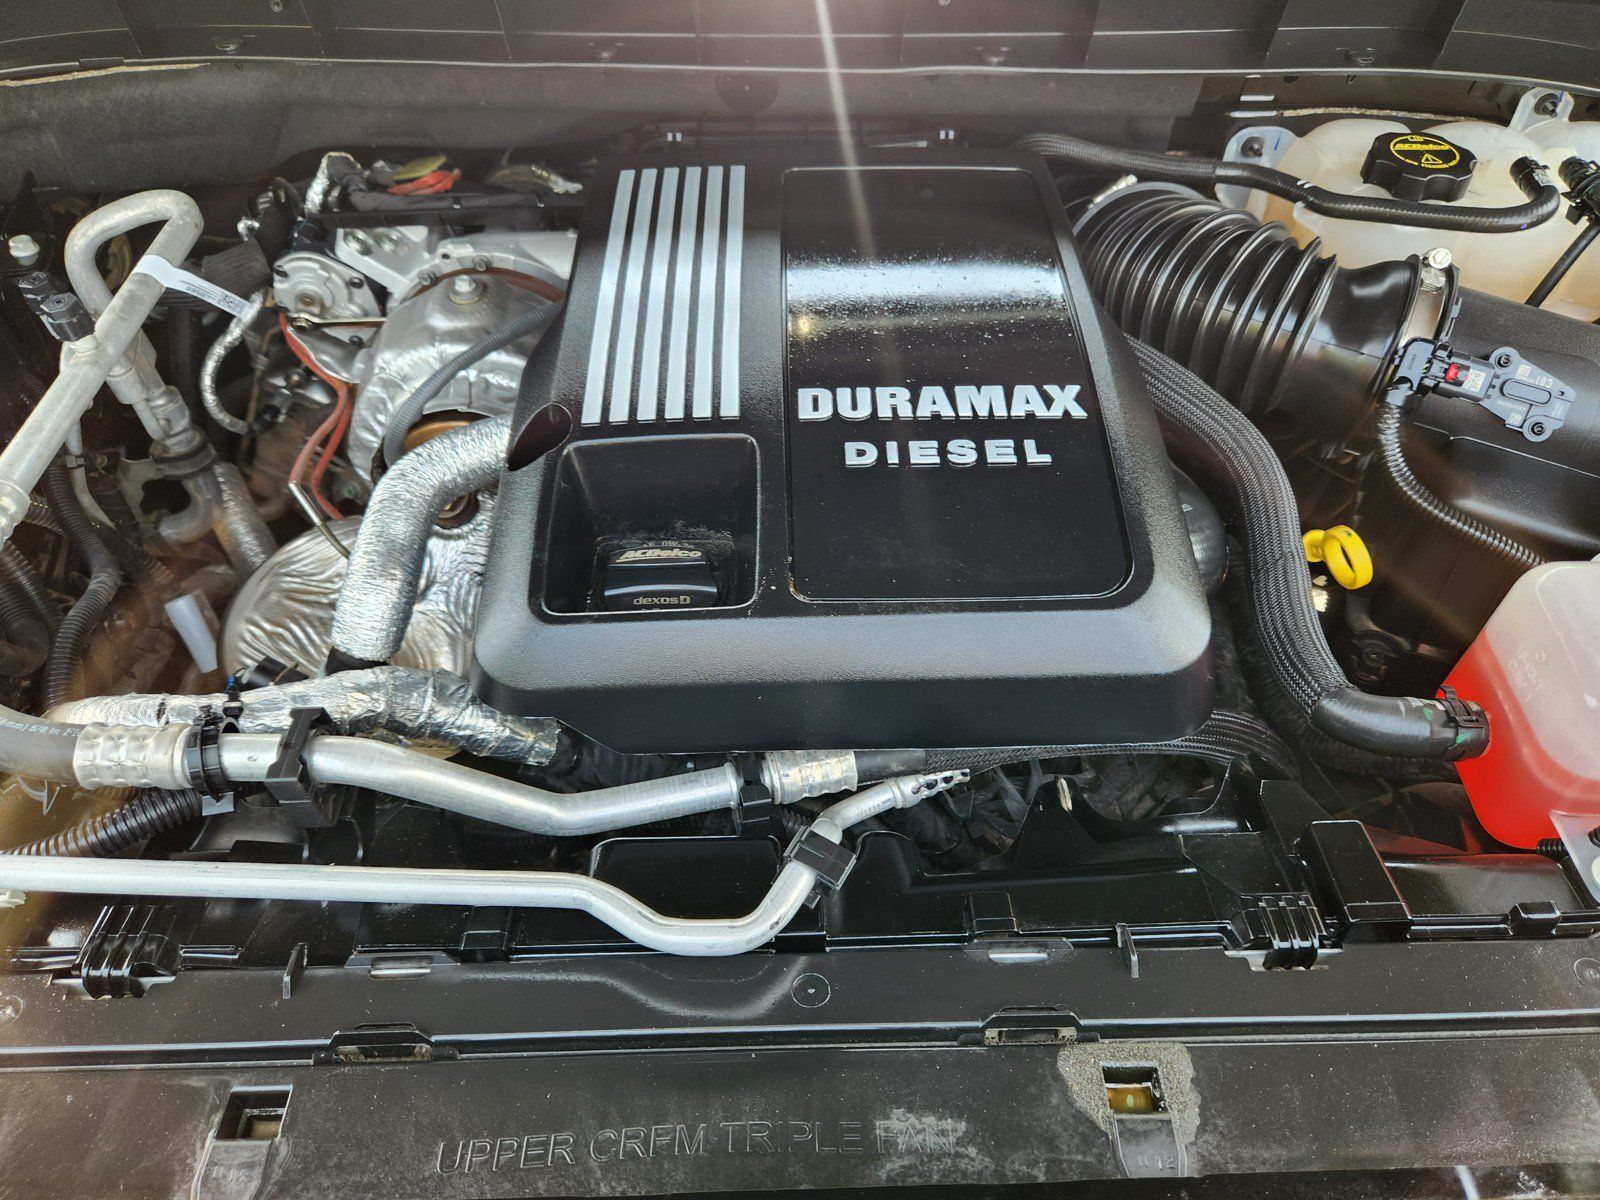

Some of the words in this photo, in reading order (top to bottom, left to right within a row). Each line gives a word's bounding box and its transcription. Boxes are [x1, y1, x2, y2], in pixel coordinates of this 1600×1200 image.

[797, 384, 1088, 421] DURAMAX
[844, 439, 1052, 467] DIESEL
[616, 548, 702, 562] ACDelco
[436, 1132, 577, 1175] UPPER
[590, 1123, 707, 1161] CRFM
[720, 1120, 863, 1154] TRIPLE
